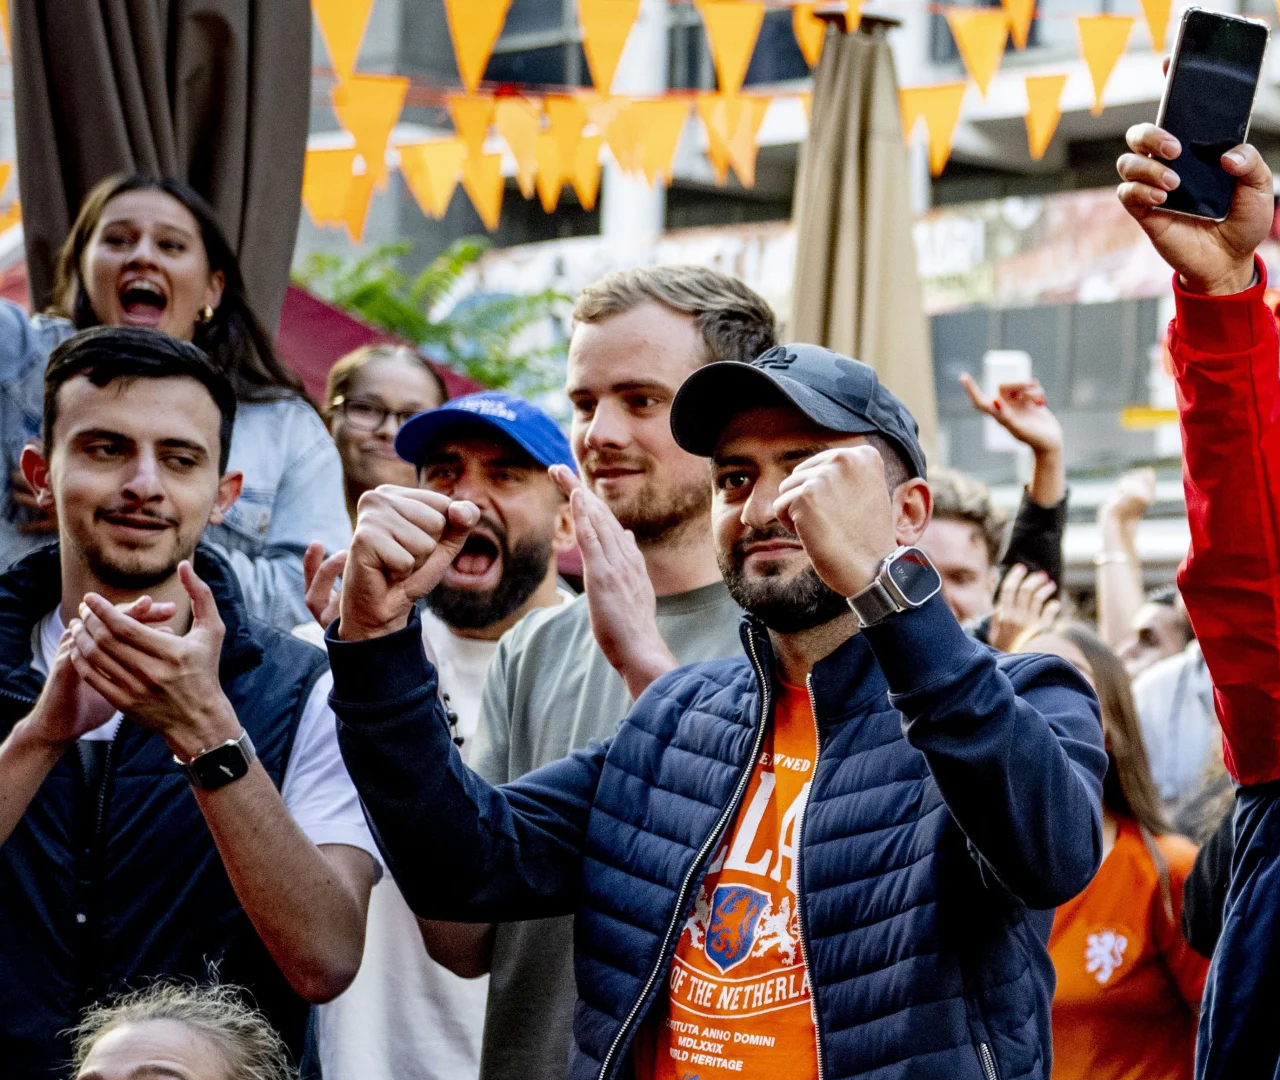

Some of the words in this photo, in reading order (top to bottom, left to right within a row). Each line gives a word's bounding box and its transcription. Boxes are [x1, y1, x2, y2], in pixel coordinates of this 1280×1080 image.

[669, 965, 688, 994] OF
[687, 976, 717, 1008] THE
[678, 1036, 724, 1054] MDLXXIX
[701, 1027, 731, 1042] ANNO
[733, 1032, 775, 1047] DOMINI
[690, 1053, 744, 1071] HERITAGE
